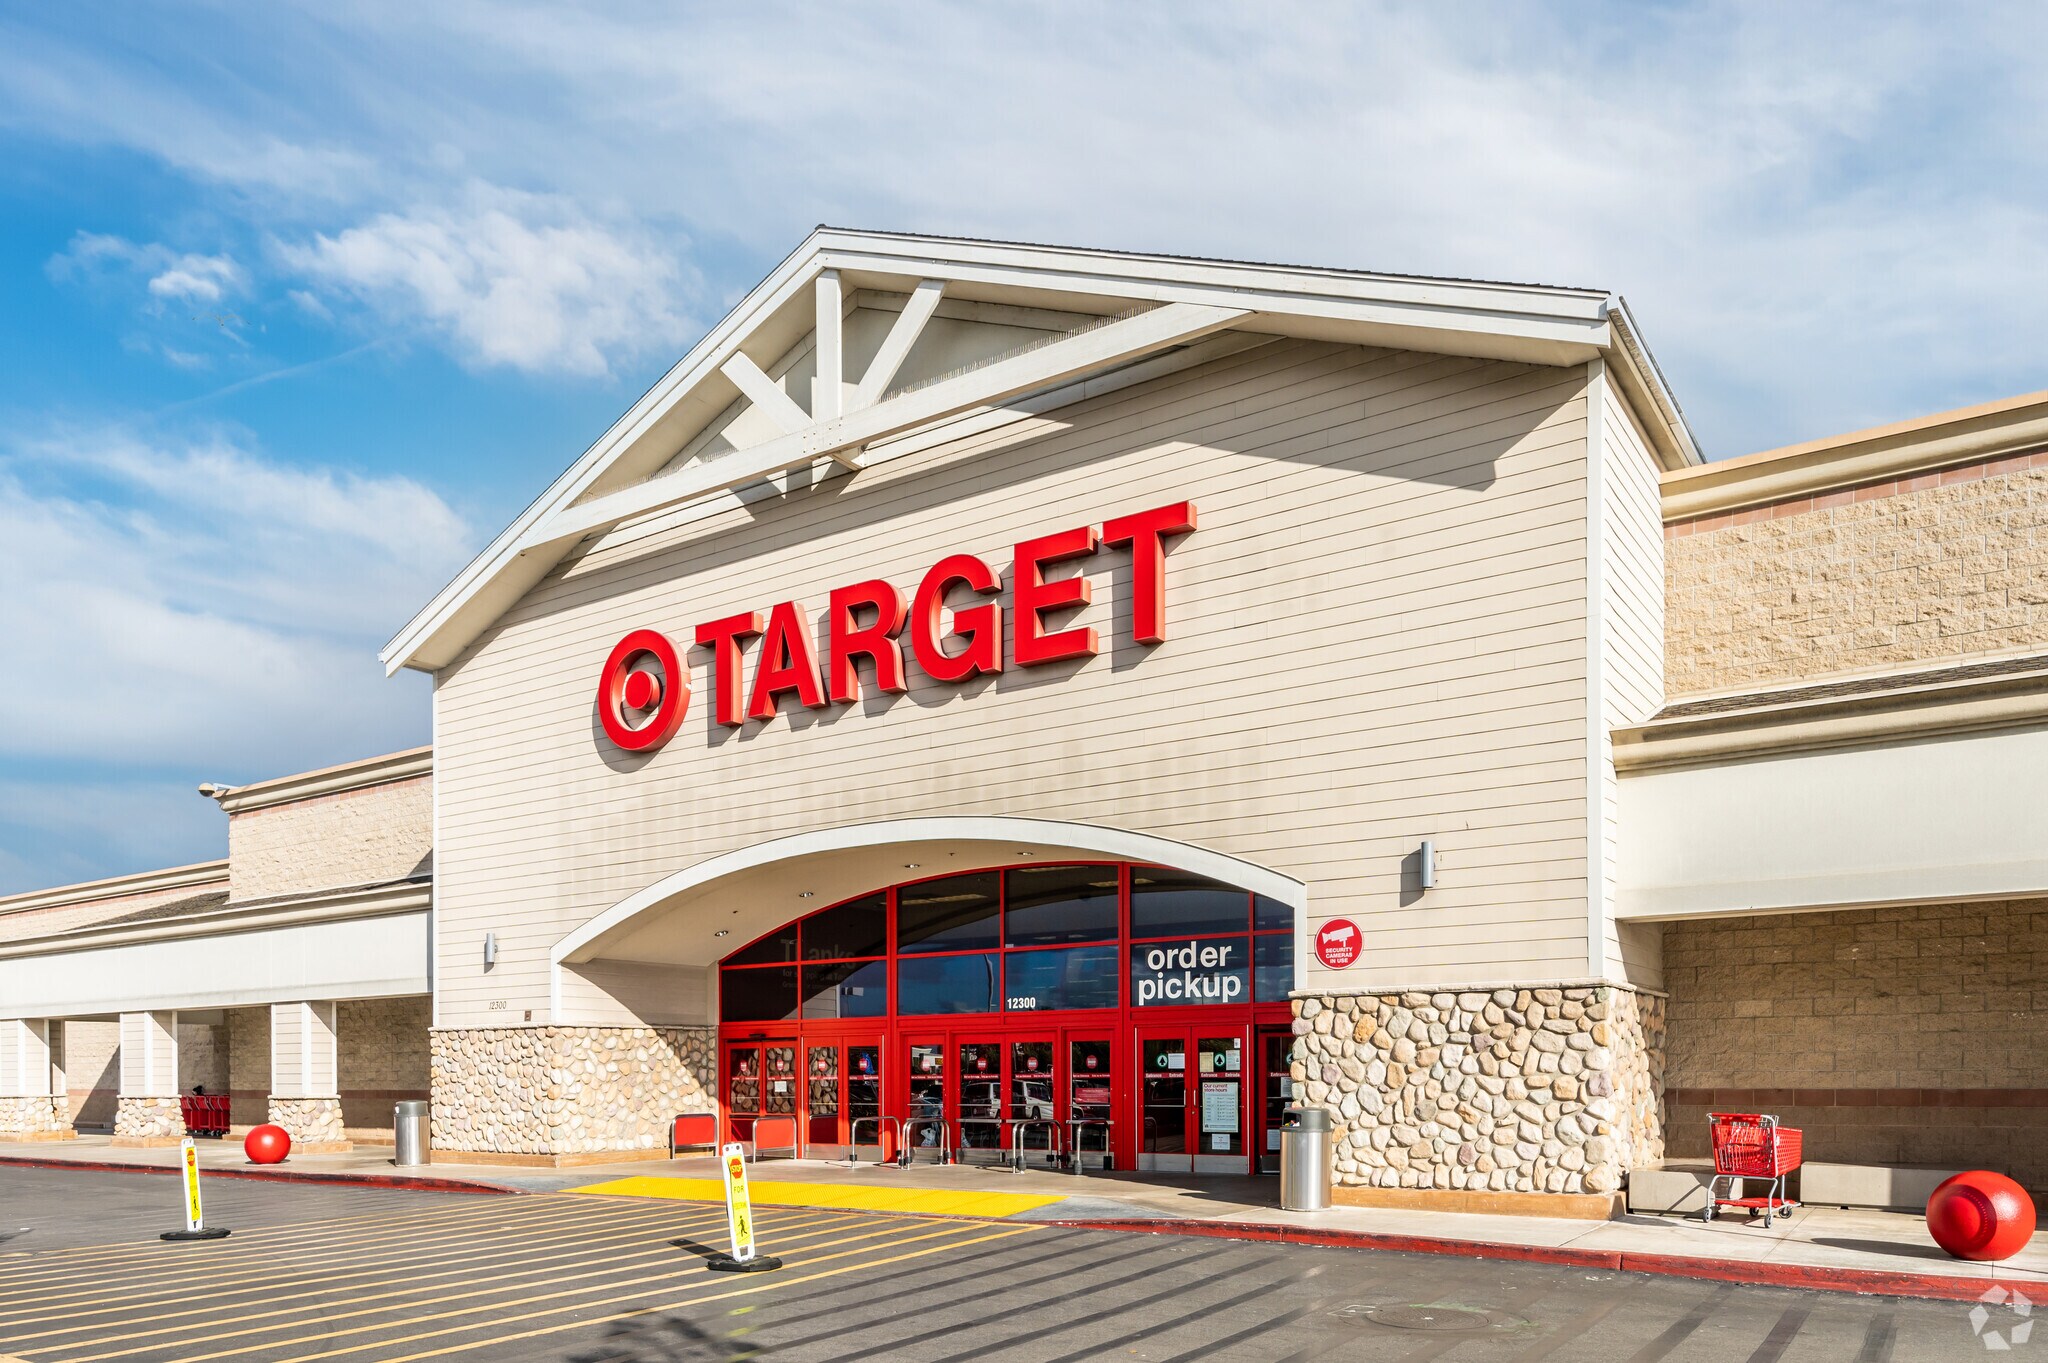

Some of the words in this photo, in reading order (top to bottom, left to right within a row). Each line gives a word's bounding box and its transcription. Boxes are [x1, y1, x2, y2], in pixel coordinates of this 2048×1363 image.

[695, 500, 1197, 727] TARGET
[1147, 941, 1232, 970] order
[1138, 971, 1242, 1006] pickup
[489, 1000, 507, 1010] 12300
[1007, 997, 1036, 1009] 12300
[733, 1185, 744, 1193] FOR
